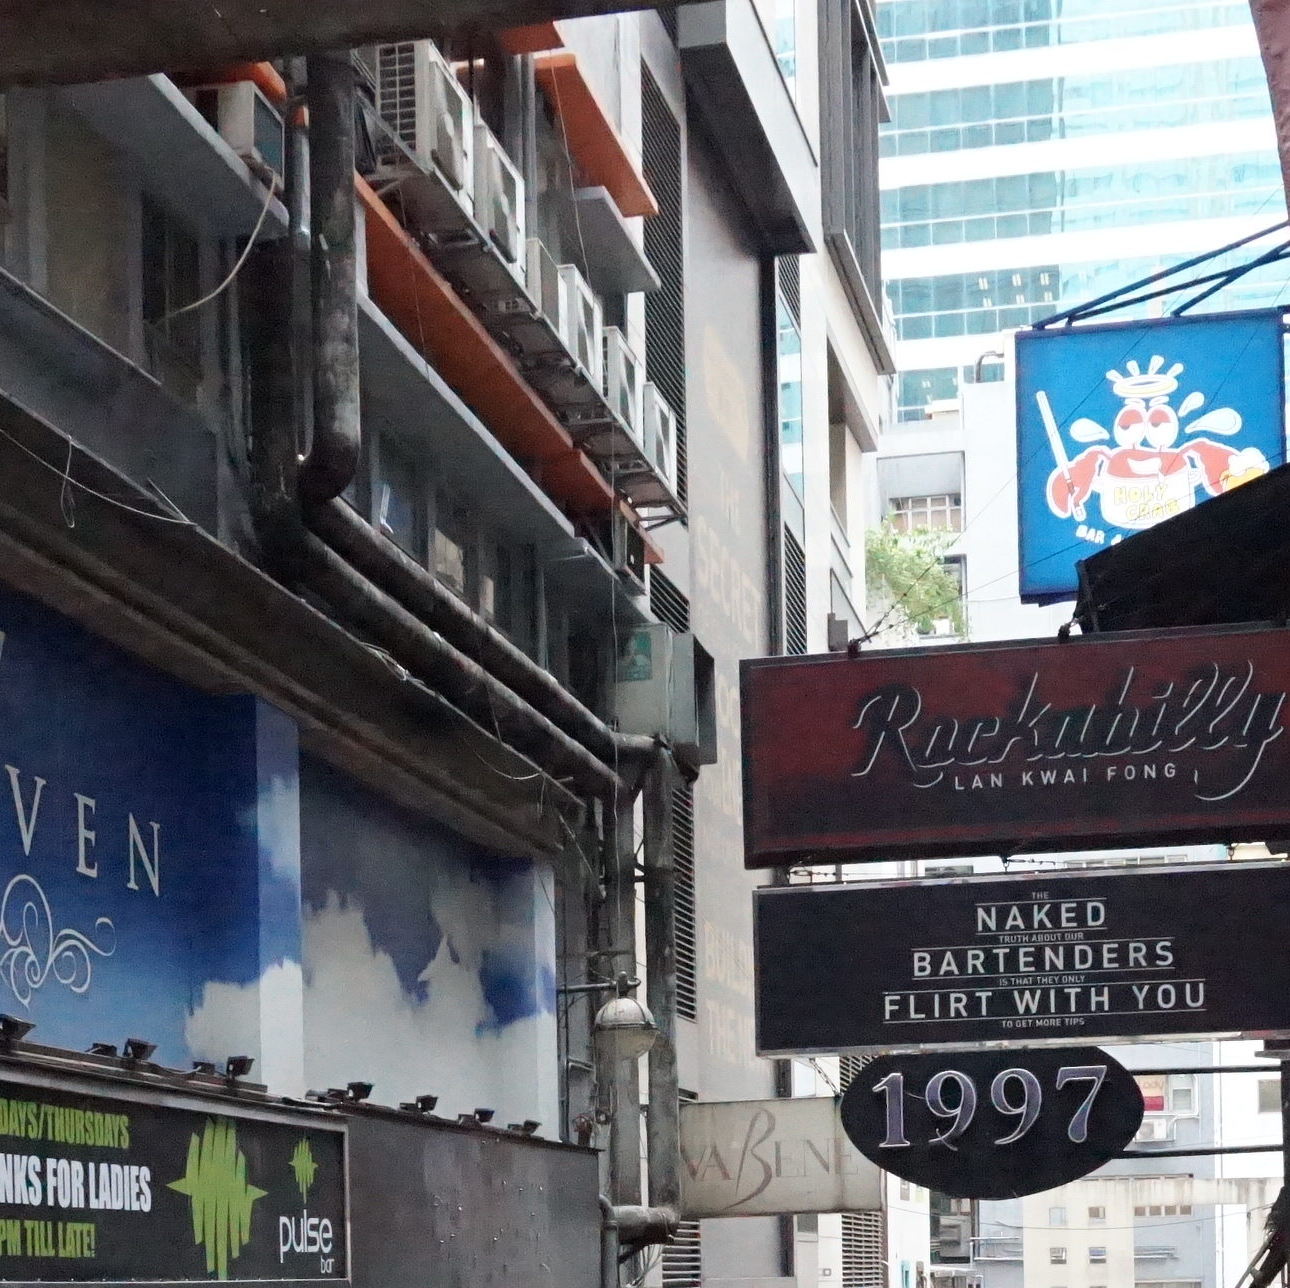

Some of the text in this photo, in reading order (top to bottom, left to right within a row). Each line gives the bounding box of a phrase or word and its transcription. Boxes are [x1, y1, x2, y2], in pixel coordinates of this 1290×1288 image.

[1114, 484, 1168, 505] HOLY
[1126, 498, 1181, 520] CRAB
[1076, 524, 1105, 545] BAR
[852, 659, 1287, 800] Rockabilly
[953, 763, 1179, 791] LAN KWAI FONG
[1031, 891, 1050, 900] THE
[977, 901, 1106, 932] NAKED
[999, 931, 1085, 943] TRUTH ABOUT OUR
[914, 941, 1174, 977] BARTENDERS
[999, 975, 1086, 986] IS THAT THEY ONLY
[885, 982, 1206, 1020] FLIRT WITH YOU
[1002, 1017, 1085, 1029] TO GET MORE TIPS
[872, 1064, 1109, 1150] 1997
[46, 1157, 85, 1210] FOR
[89, 1161, 152, 1213] LADIES
[23, 1219, 55, 1257] TILL
[57, 1222, 96, 1258] LATE!
[279, 1208, 333, 1263] pulse
[320, 1257, 335, 1274] bar
